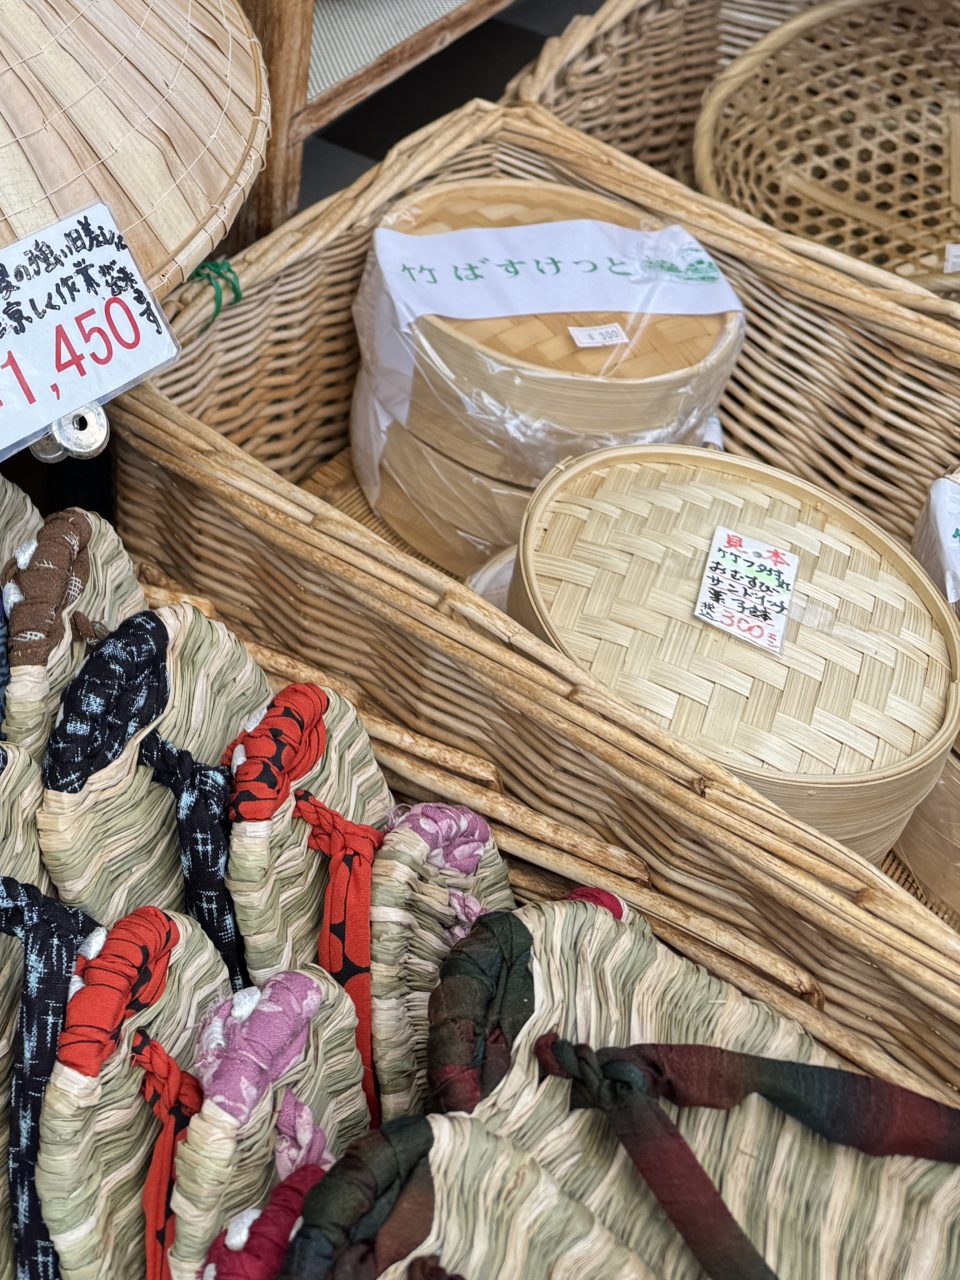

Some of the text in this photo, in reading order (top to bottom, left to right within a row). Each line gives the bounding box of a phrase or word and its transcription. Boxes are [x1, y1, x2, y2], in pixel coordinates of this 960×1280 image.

[401, 255, 634, 285] 竹ばすけっと
